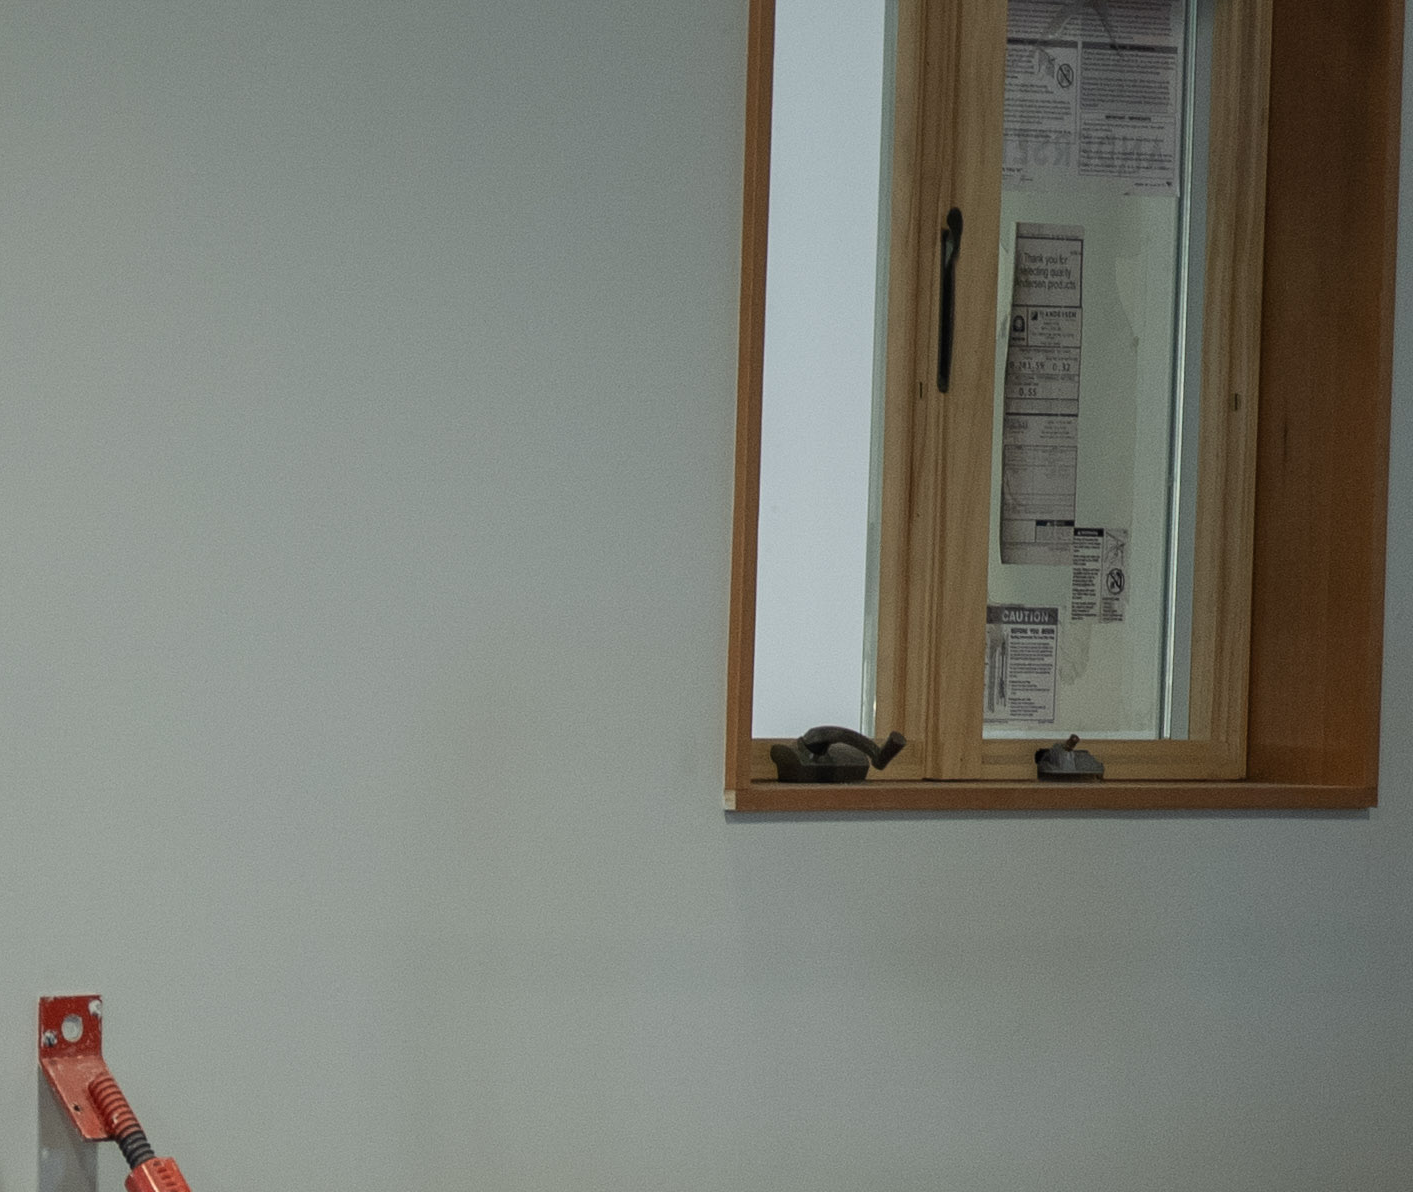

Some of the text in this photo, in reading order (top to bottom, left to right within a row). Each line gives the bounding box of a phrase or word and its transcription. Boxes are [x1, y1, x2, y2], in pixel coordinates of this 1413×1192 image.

[1024, 253, 1068, 265] Thank you for
[1019, 387, 1037, 396] 0.55
[1002, 609, 1049, 622] CAUTION
